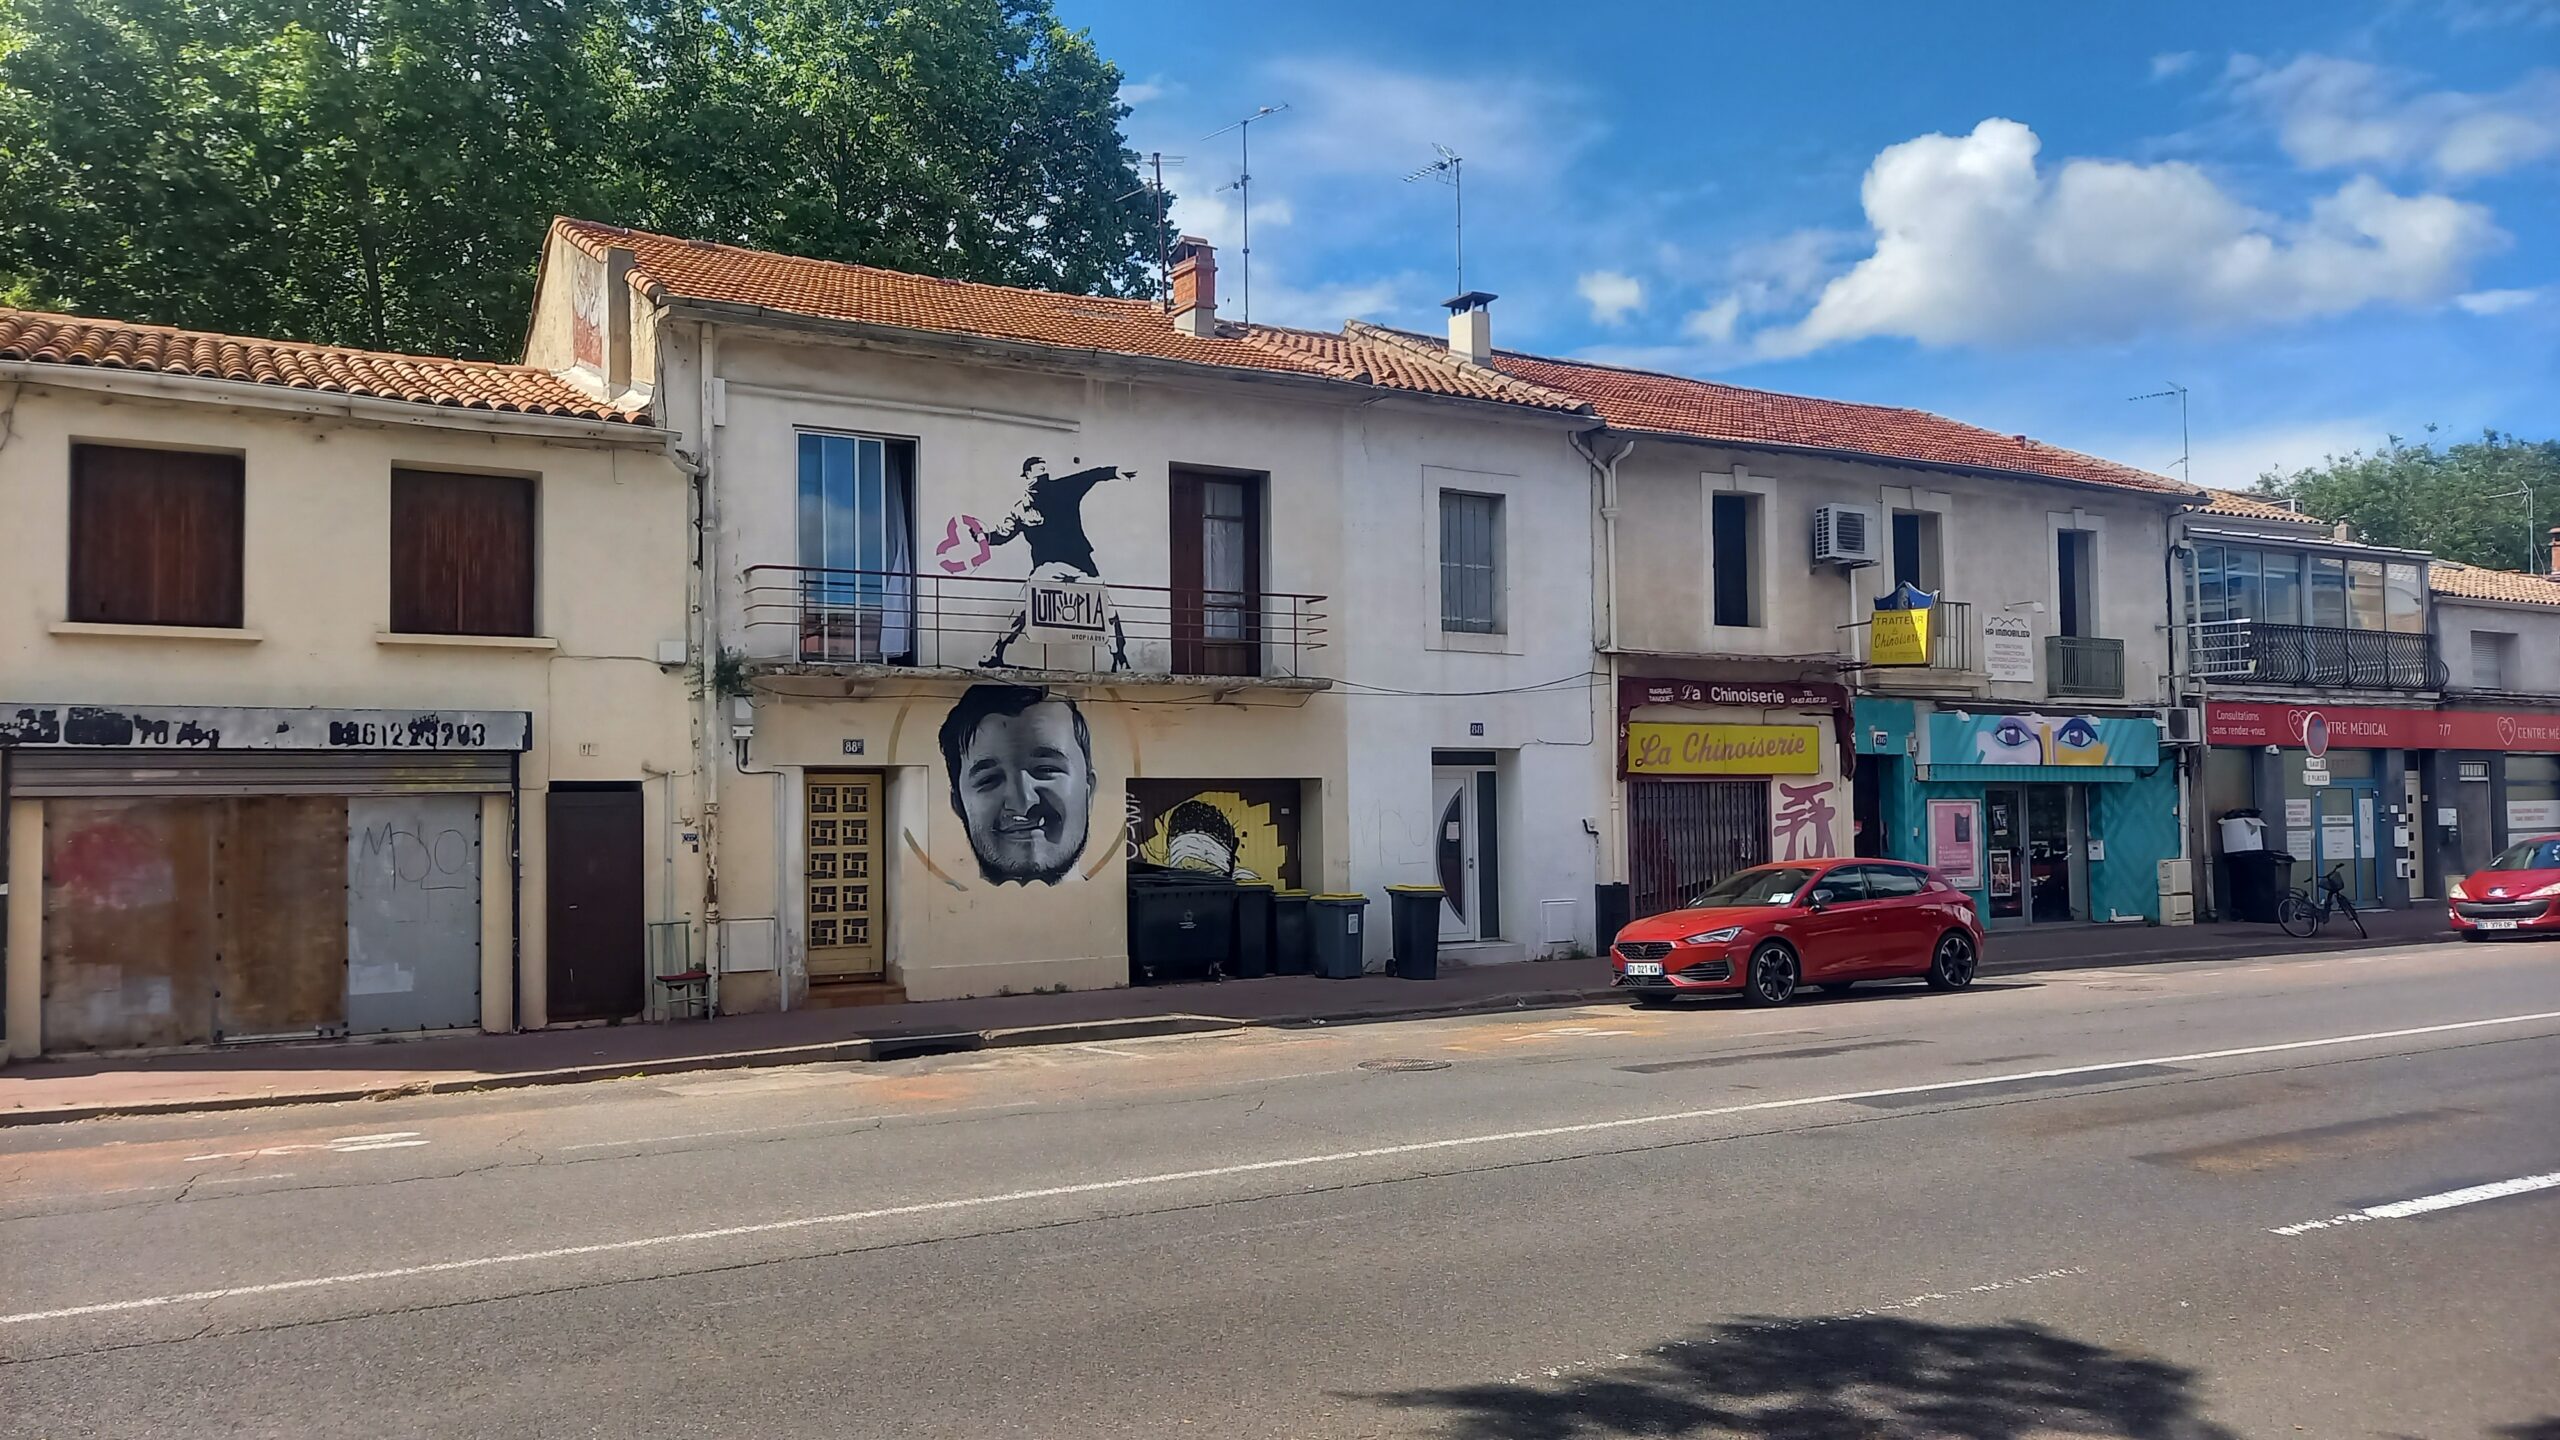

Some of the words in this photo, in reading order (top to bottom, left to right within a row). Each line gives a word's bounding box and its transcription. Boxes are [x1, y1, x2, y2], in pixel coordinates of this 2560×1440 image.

[1711, 687, 1785, 704] Chinoiserie
[2216, 710, 2260, 721] Consultations
[1471, 724, 1483, 734] 88
[2211, 727, 2227, 735] sans
[2228, 726, 2266, 736] rendez-vous
[2327, 721, 2348, 735] NTRE
[2350, 721, 2389, 736] MÉDICAL
[2438, 723, 2452, 736] 7/7
[2517, 727, 2546, 739] CENTRE
[1635, 734, 1673, 768] La
[1682, 732, 1806, 764] Chinoiserie
